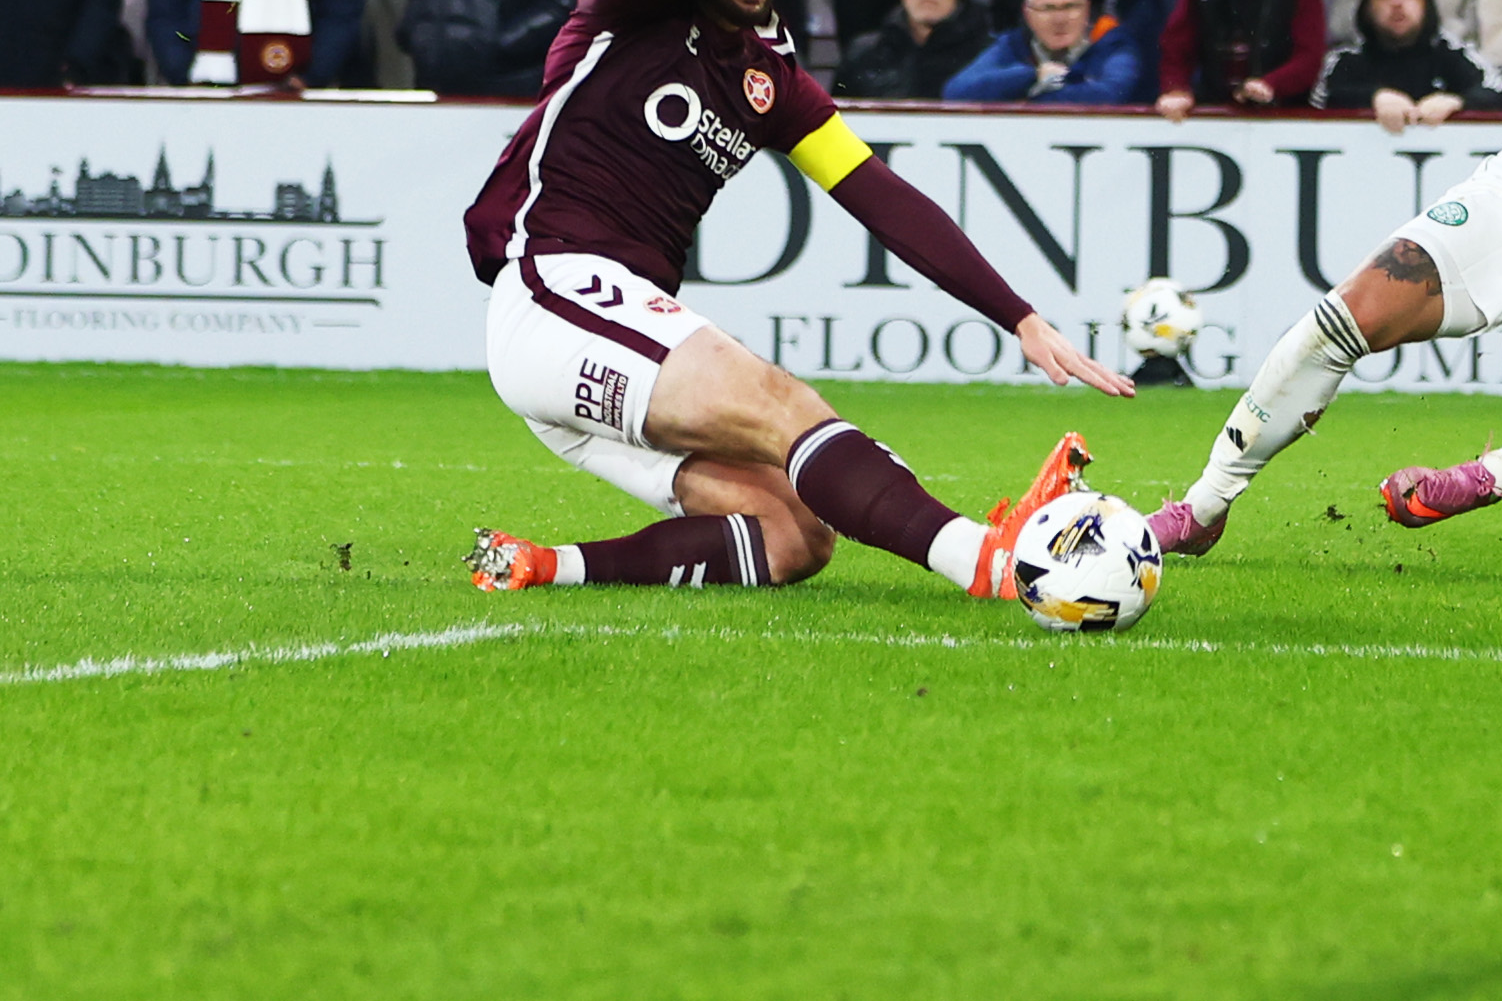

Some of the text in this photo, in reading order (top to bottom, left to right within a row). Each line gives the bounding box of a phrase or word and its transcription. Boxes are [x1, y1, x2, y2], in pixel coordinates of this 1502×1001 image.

[13, 309, 305, 335] FLOORING COMPANY
[574, 356, 608, 424] PPE
